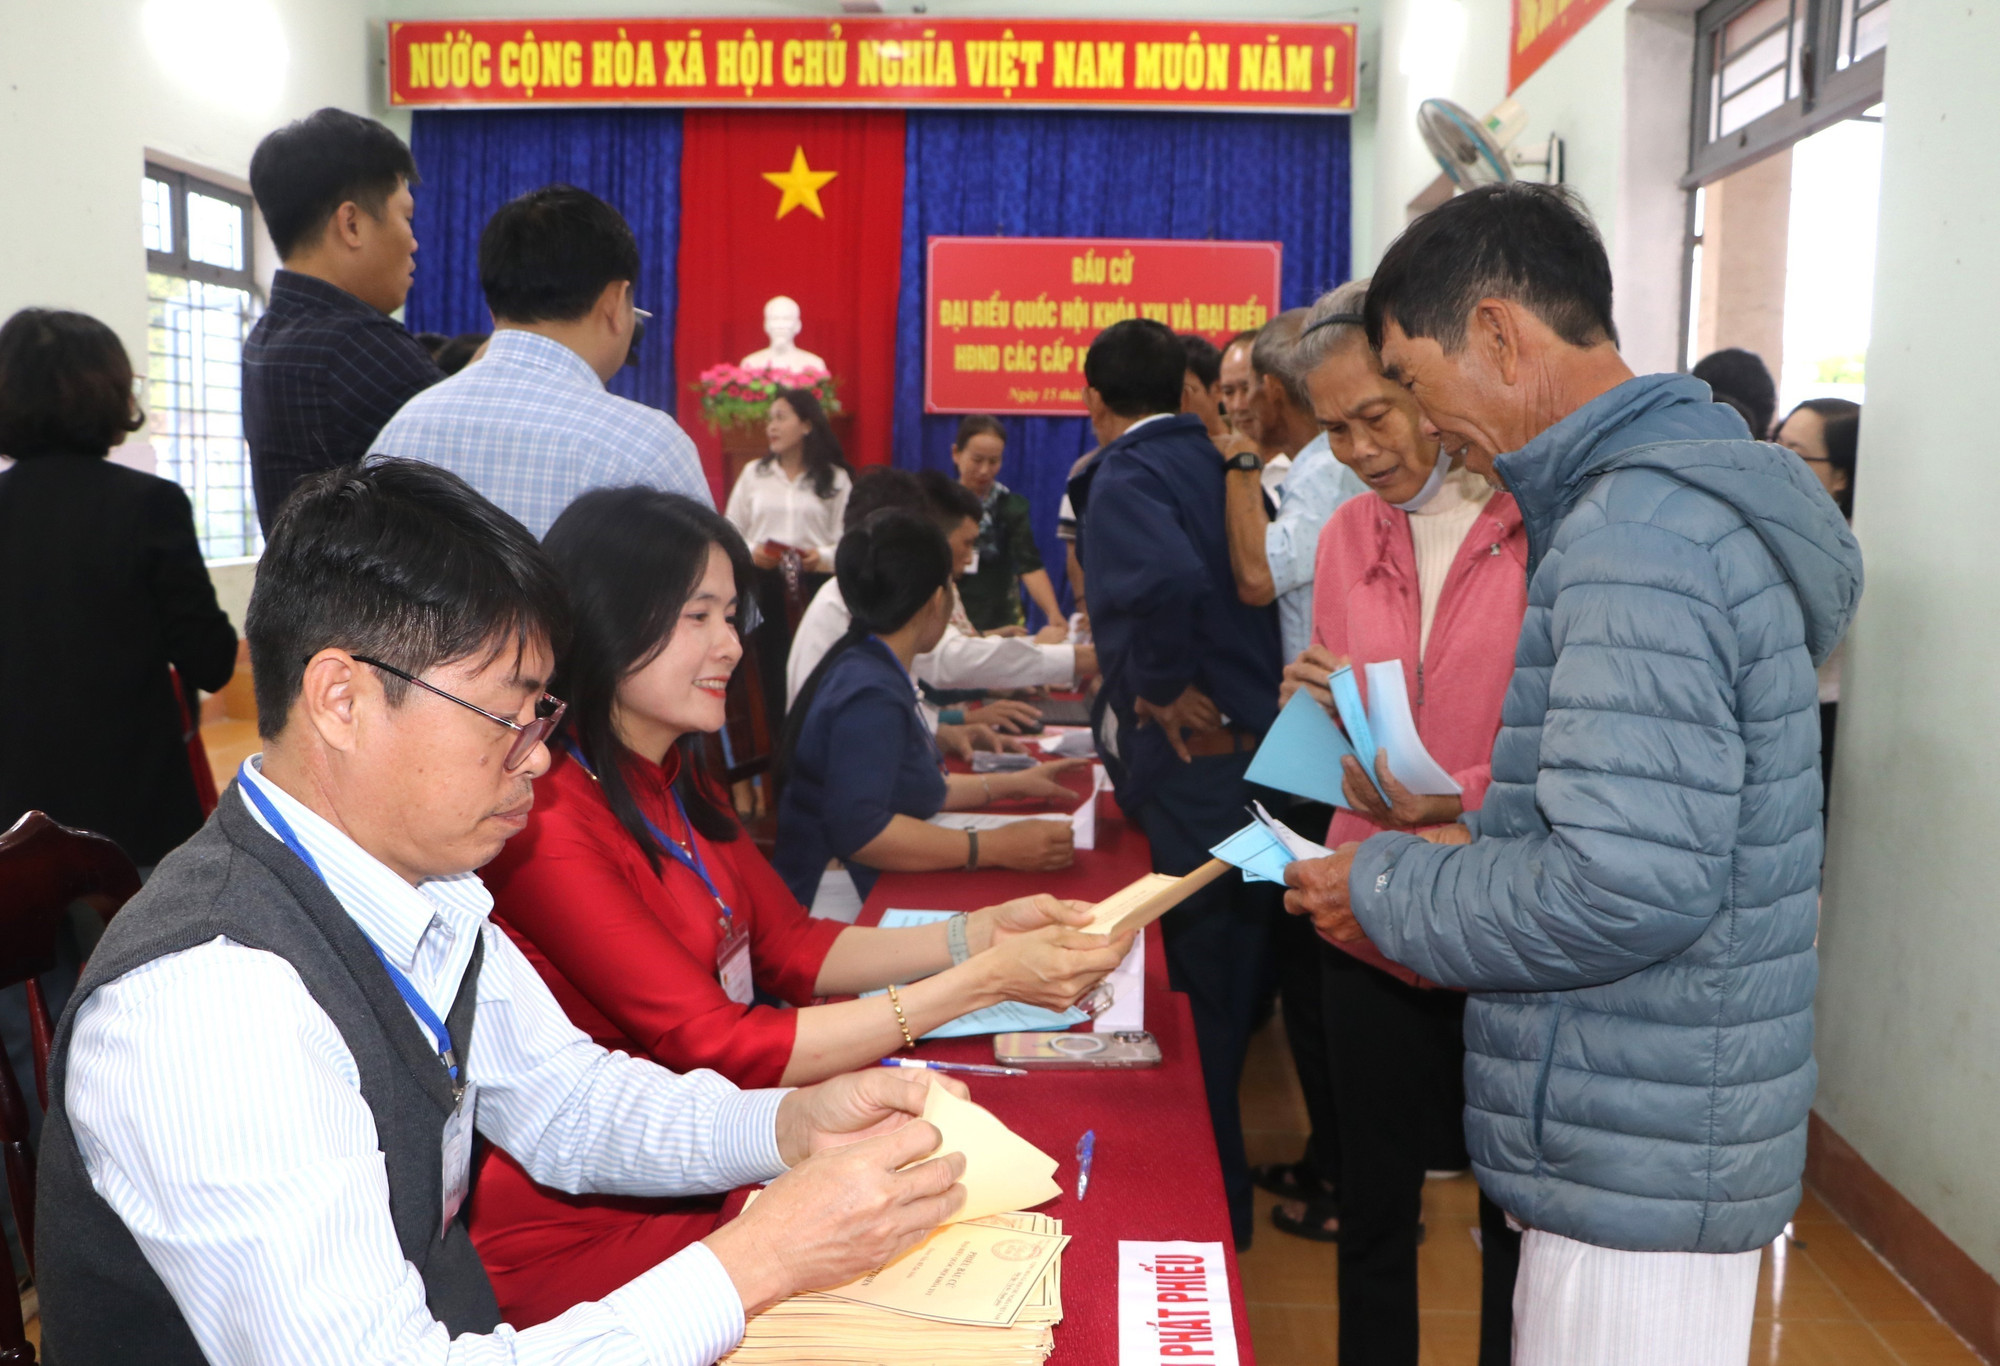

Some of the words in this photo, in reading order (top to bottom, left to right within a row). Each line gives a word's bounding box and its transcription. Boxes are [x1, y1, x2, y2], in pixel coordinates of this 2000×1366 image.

[409, 30, 492, 88] NƯỚC
[500, 29, 583, 99] CỘNG
[592, 27, 657, 87] HÒA
[664, 28, 707, 87] XÃ
[717, 27, 774, 97] HỘI
[782, 23, 848, 87] CHỦ
[858, 28, 957, 88] NGHĨA
[965, 28, 1044, 98] VIỆT
[1053, 40, 1124, 89] NAM
[1135, 30, 1231, 91] MUÔN
[1238, 34, 1313, 92] NĂM
[1324, 45, 1337, 94] !
[1109, 248, 1135, 285] CỬ
[939, 299, 969, 332] ĐẠI
[972, 290, 1010, 328] BIỂU
[1013, 291, 1056, 331] QUỐC
[1061, 295, 1089, 334] HỘI
[1093, 296, 1137, 328] KHÓA
[1171, 297, 1195, 330] VÀ
[1196, 303, 1226, 337] ĐẠI
[1003, 339, 1038, 372] CÁC
[1040, 336, 1075, 372] CẤP
[1138, 1254, 1208, 1303] PHIẾU
[1146, 1308, 1215, 1356] PHÁT
